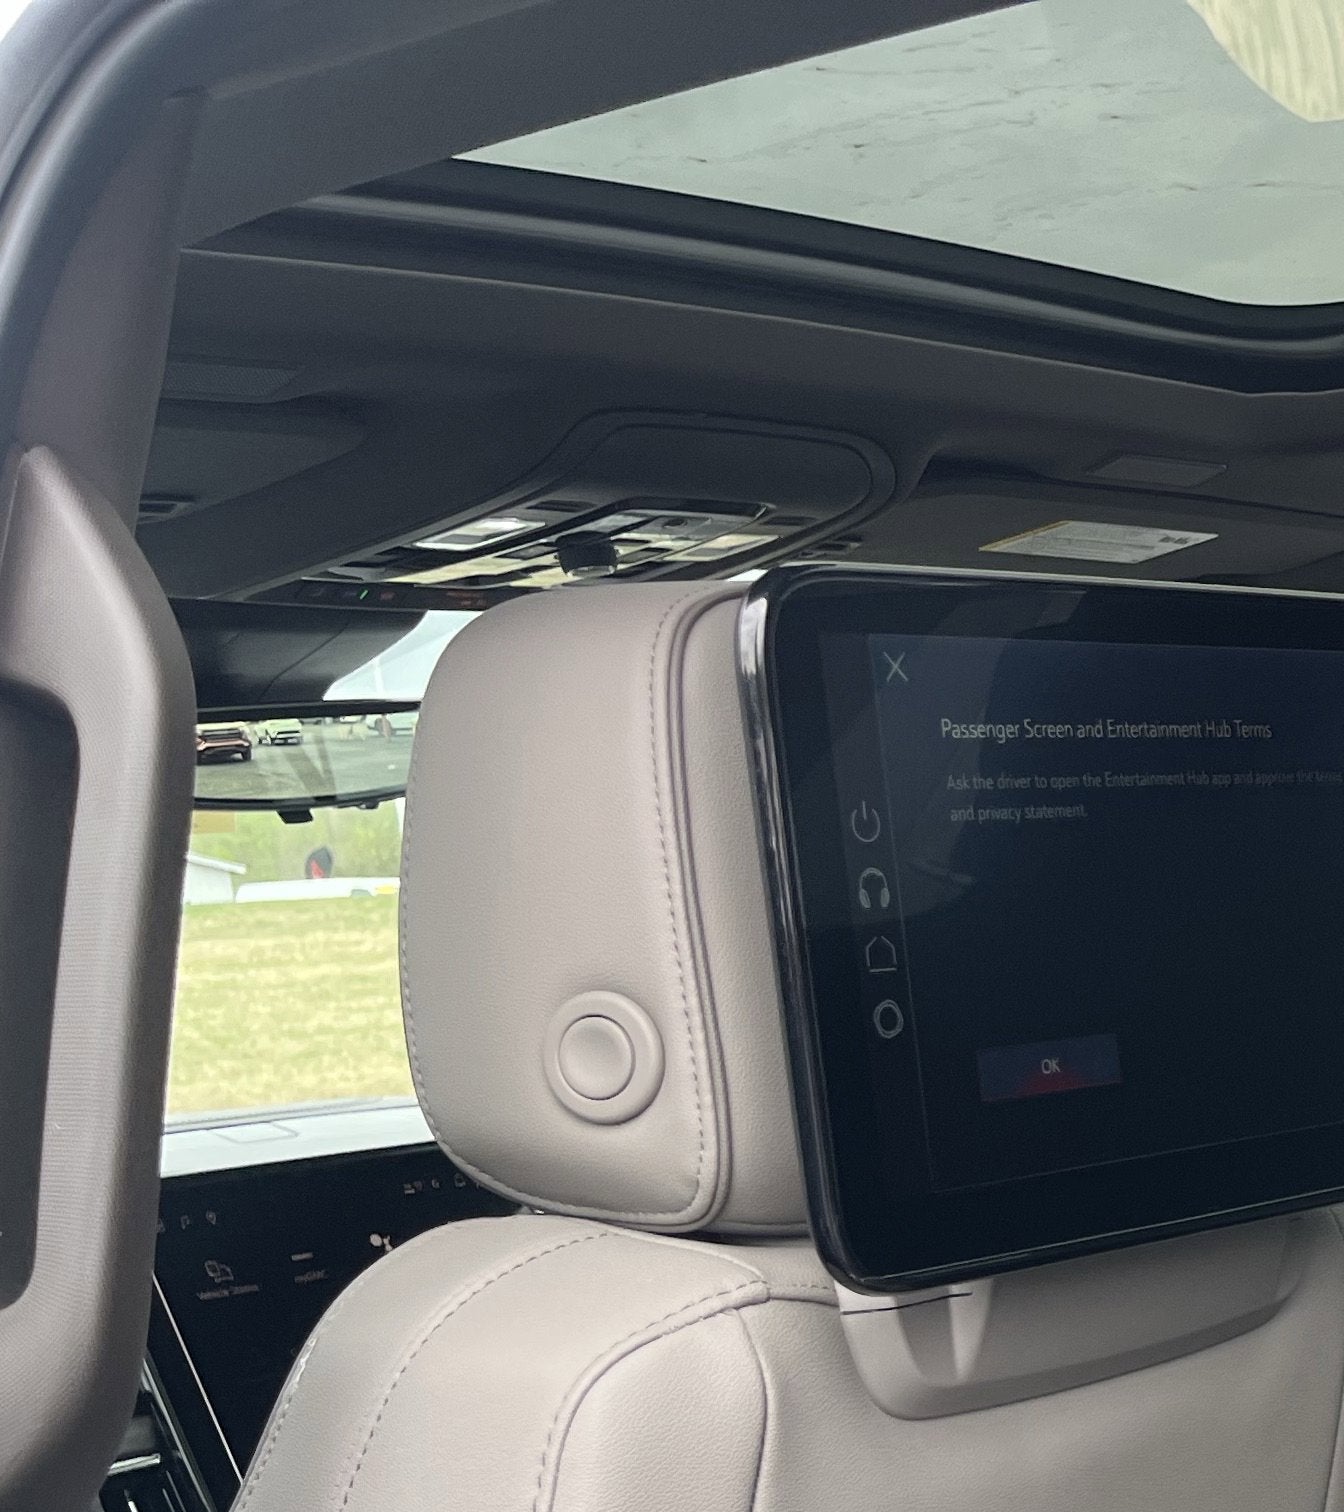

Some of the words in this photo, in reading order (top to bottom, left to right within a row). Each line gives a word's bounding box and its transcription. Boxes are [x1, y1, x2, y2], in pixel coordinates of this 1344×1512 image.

[941, 718, 1020, 744] Passenger
[1023, 718, 1073, 739] Screen
[1076, 720, 1103, 739] and
[1107, 719, 1201, 739] Entertainment
[1205, 719, 1231, 738] Hub
[1234, 719, 1272, 739] Terms
[947, 774, 969, 791] Ask
[972, 774, 994, 790] the
[997, 773, 1031, 789] driver
[1034, 774, 1049, 789] to
[1051, 776, 1080, 792] open
[1082, 772, 1102, 788] the
[1104, 771, 1185, 787] Entertainment
[1212, 773, 1231, 788] app
[950, 805, 975, 822] and
[978, 806, 1021, 824] privacy
[1041, 1058, 1060, 1074] OK
